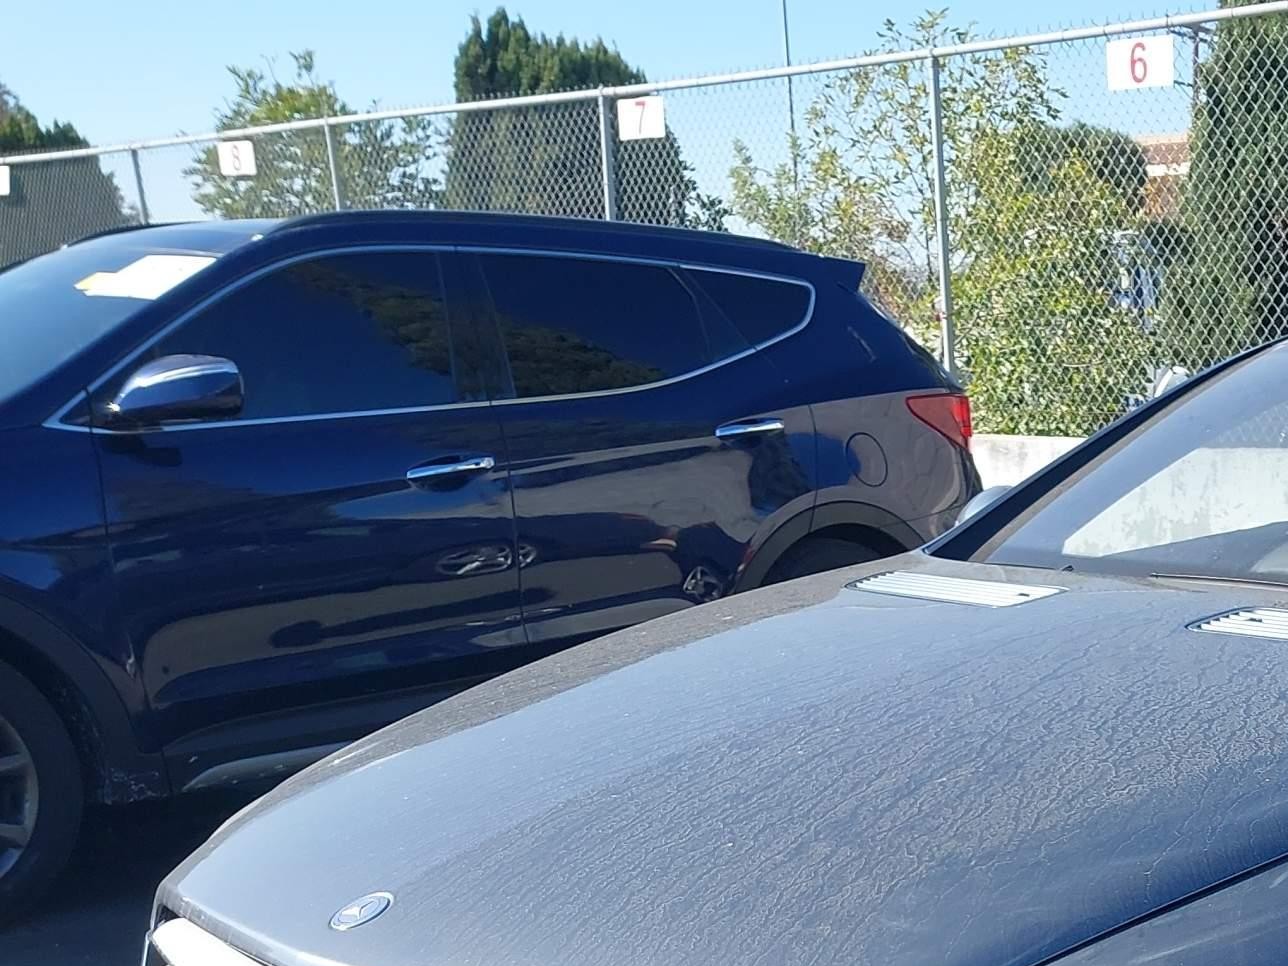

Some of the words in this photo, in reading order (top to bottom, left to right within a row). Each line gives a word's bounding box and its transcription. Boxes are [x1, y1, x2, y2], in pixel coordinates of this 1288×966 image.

[1131, 42, 1147, 83] 6
[635, 101, 645, 134] 7
[232, 144, 241, 171] 8
